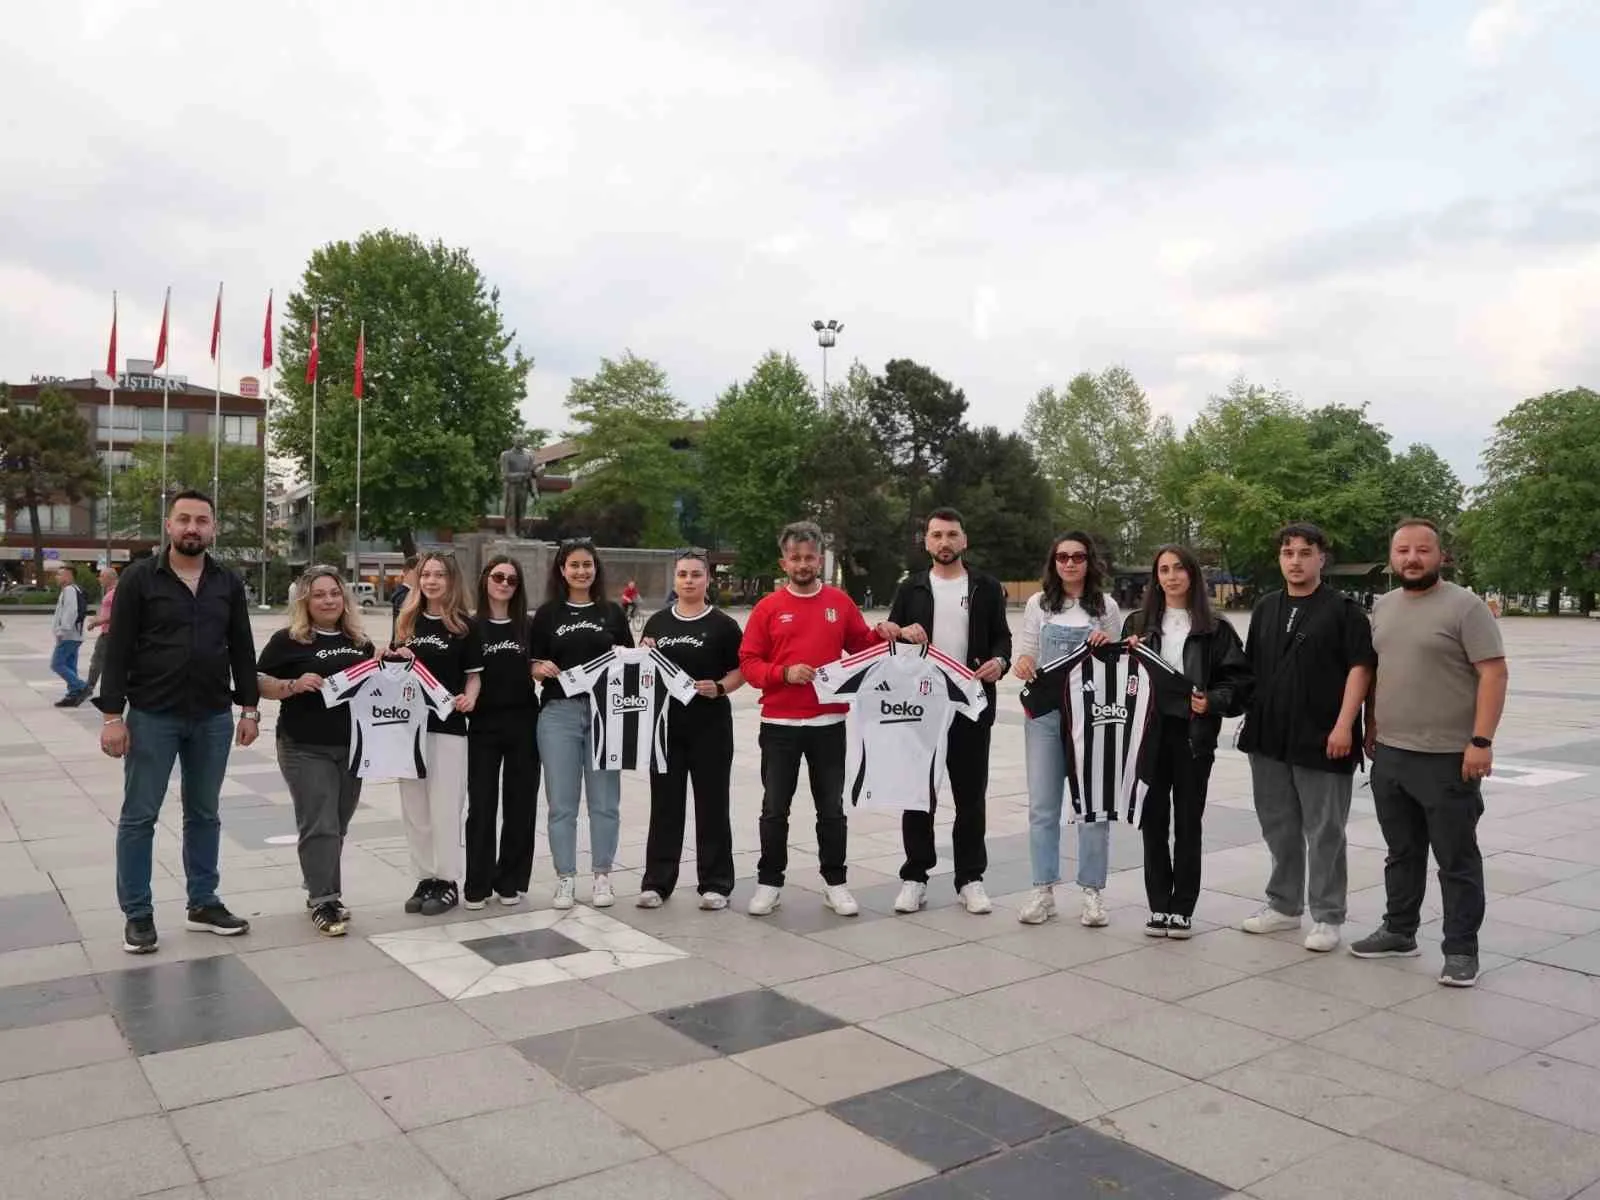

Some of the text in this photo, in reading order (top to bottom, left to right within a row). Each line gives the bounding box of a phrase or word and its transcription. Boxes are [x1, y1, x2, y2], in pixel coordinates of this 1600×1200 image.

[612, 693, 649, 707] beko
[372, 705, 410, 719] beko
[880, 699, 924, 716] beko
[1091, 703, 1128, 718] beko
